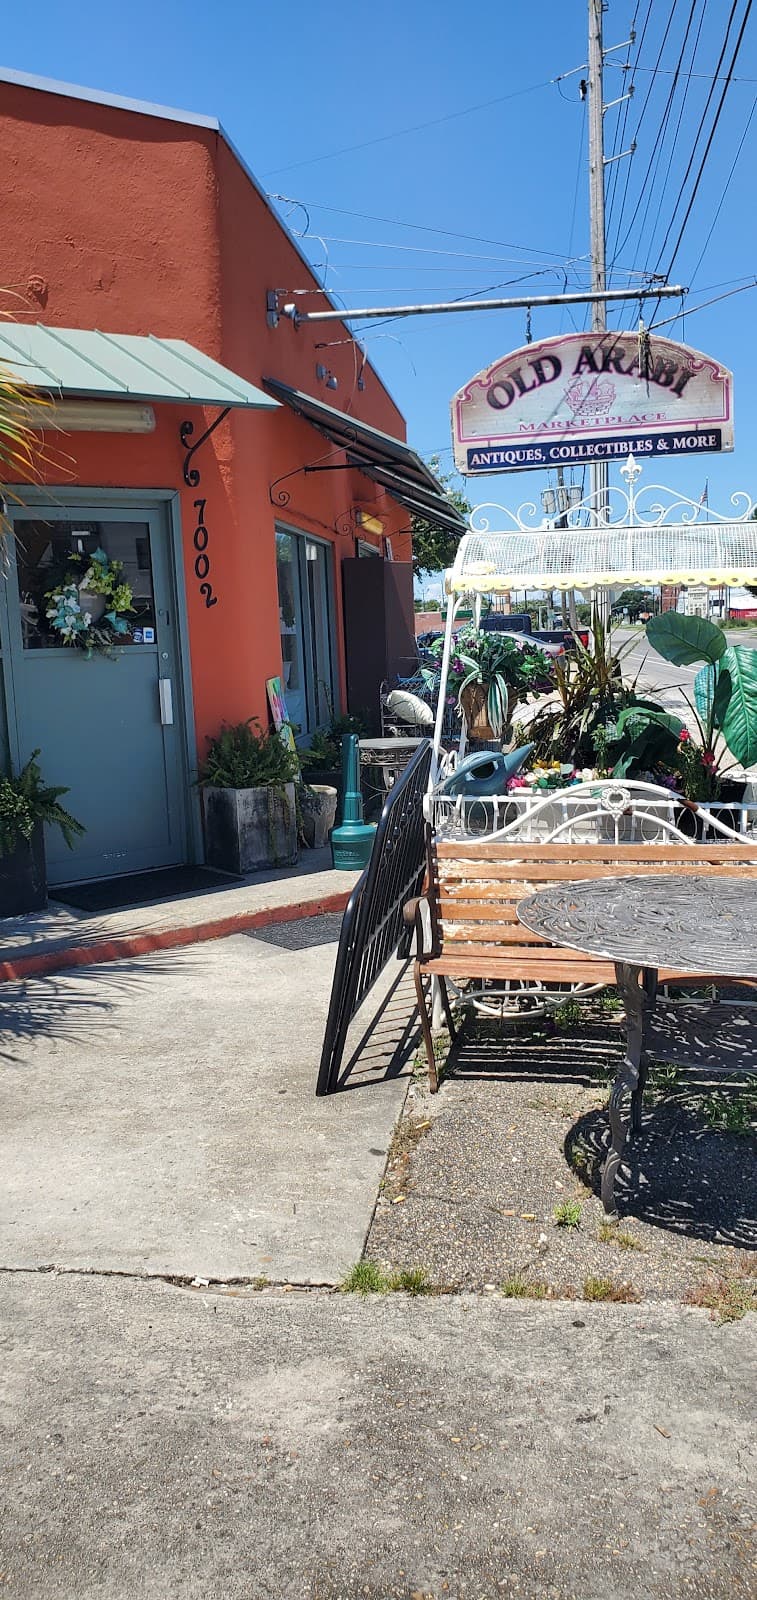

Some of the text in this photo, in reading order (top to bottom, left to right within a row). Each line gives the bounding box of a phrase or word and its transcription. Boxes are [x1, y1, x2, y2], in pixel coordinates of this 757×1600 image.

[486, 345, 698, 411] OLD ARABI
[519, 412, 667, 432] MARKETPLACE
[470, 434, 718, 466] ANTIQUES, COLLECTIBLES & MORE
[193, 498, 218, 608] 7002
